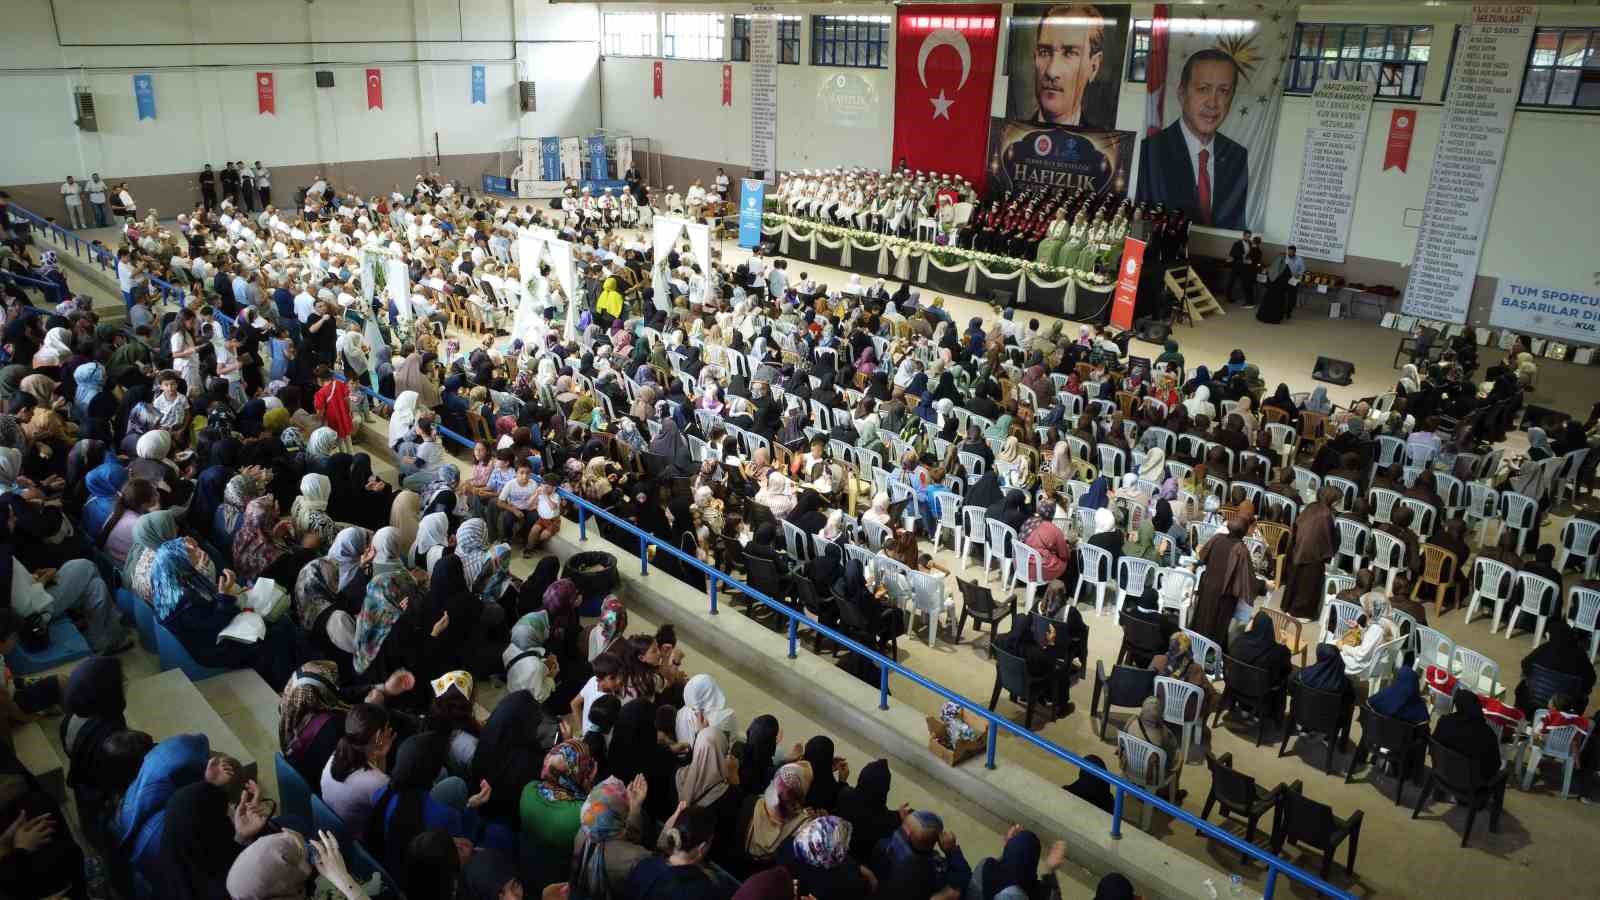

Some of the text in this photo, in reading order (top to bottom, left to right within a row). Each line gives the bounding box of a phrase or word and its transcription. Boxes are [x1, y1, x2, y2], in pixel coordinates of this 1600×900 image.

[1014, 163, 1096, 192] HAFIZLIK
[1502, 297, 1579, 317] BAŞARILAR
[1541, 289, 1600, 307] SPORCU
